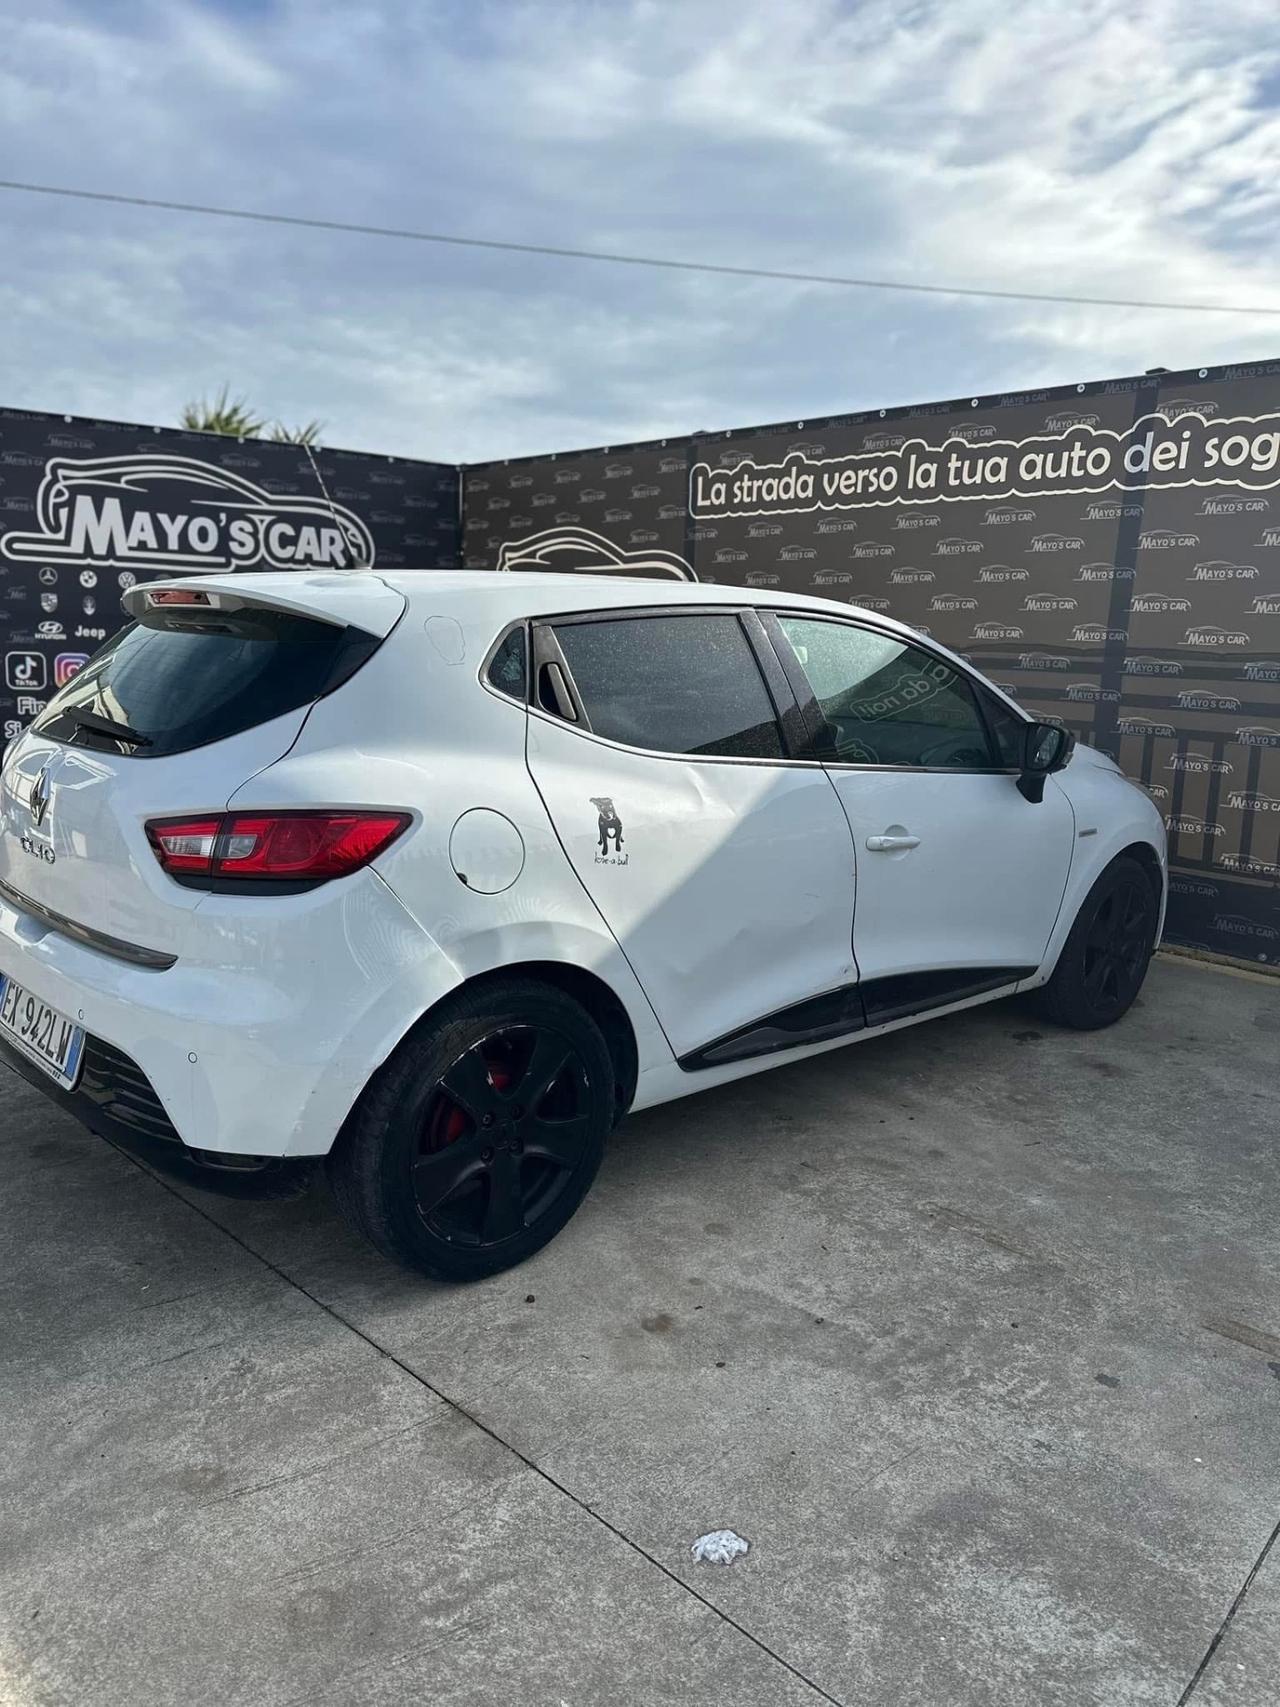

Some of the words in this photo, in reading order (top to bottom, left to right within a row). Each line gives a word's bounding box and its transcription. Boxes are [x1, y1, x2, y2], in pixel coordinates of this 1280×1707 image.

[697, 476, 726, 506] La
[733, 466, 814, 503] strada
[823, 465, 898, 495] verso
[908, 454, 937, 489] la
[948, 453, 1008, 486] tua
[1019, 442, 1111, 481] auto
[1124, 431, 1192, 473] dei
[1245, 501, 1264, 511] CAR
[1124, 507, 1140, 516] CAR
[70, 495, 255, 556] MAYO'S
[269, 522, 346, 567] CAR
[1066, 541, 1081, 549] CAR
[1178, 538, 1196, 547] CAR
[1116, 570, 1132, 579] CAR
[1236, 570, 1254, 579] CAR
[1059, 601, 1074, 610] CAR
[1170, 602, 1188, 611] CAR
[75, 625, 106, 641] Jeep
[1007, 630, 1020, 638] CAR
[1227, 635, 1246, 645] CAR
[1219, 700, 1237, 711] CAR
[1211, 764, 1229, 774] CAR
